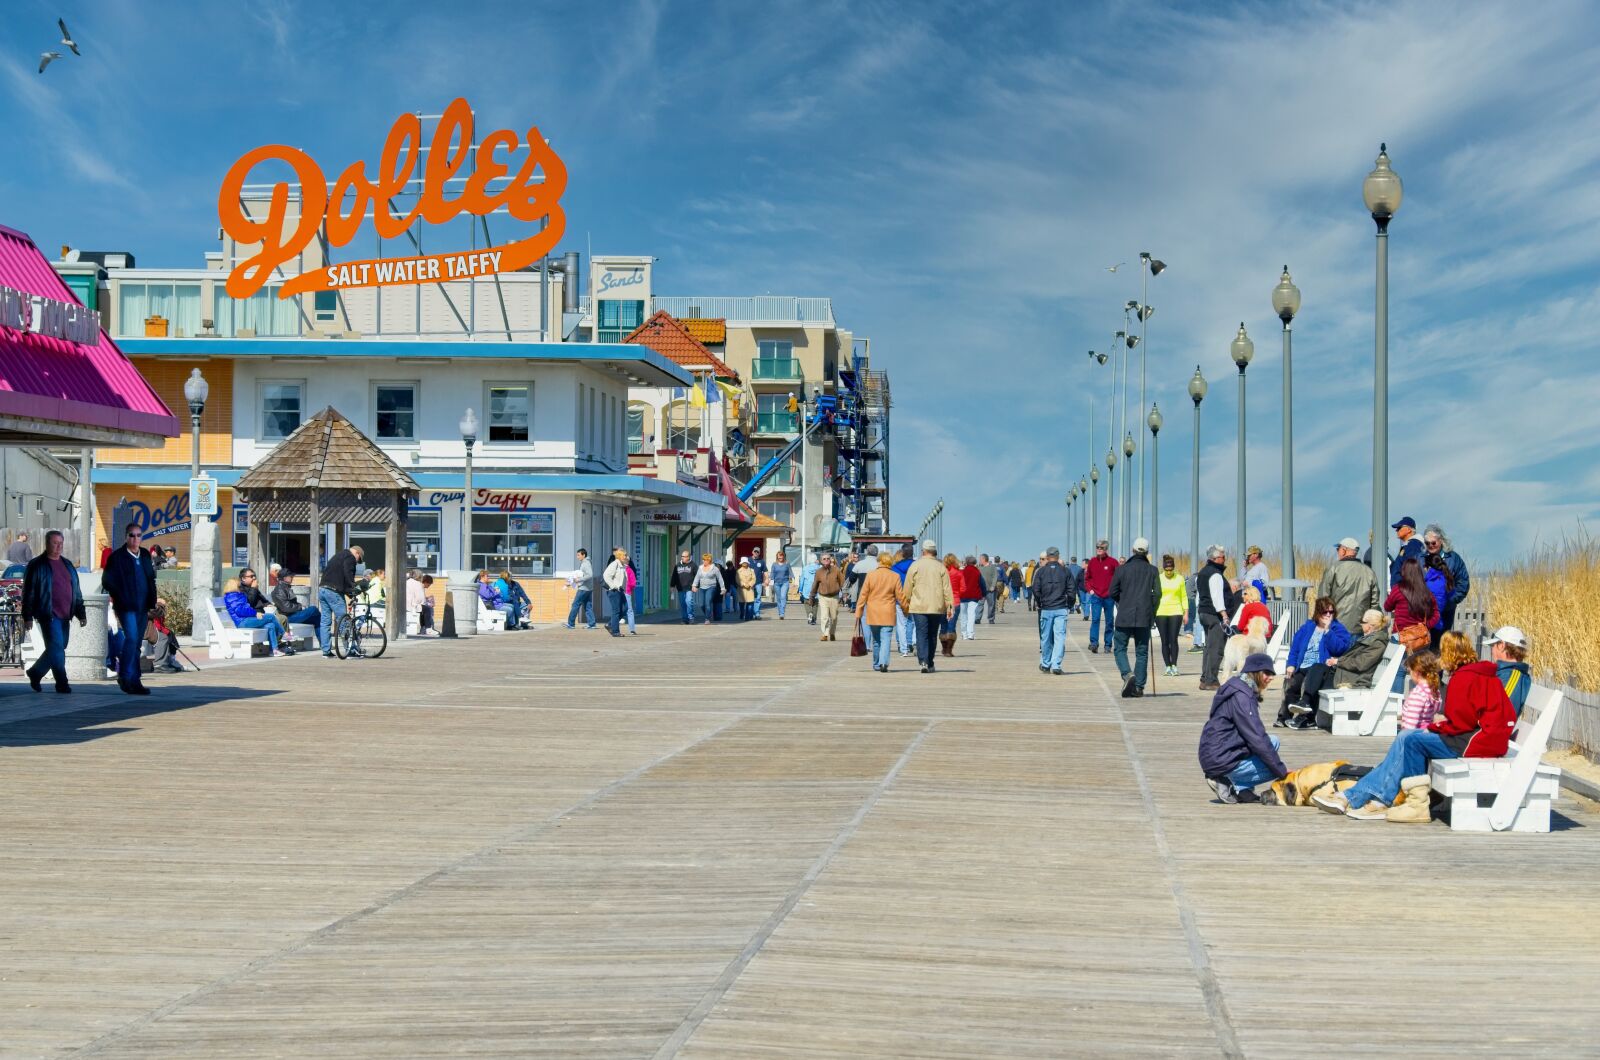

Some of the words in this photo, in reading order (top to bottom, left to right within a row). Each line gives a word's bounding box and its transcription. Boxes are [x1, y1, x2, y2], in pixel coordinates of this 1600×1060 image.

[218, 98, 567, 299] Dolles
[327, 264, 370, 287] SALT
[374, 258, 440, 283] WATER
[444, 251, 502, 278] TAFFY
[597, 268, 643, 293] Sands
[474, 489, 532, 512] Taffy
[153, 529, 166, 537] SALT
[168, 522, 189, 533] WATER
